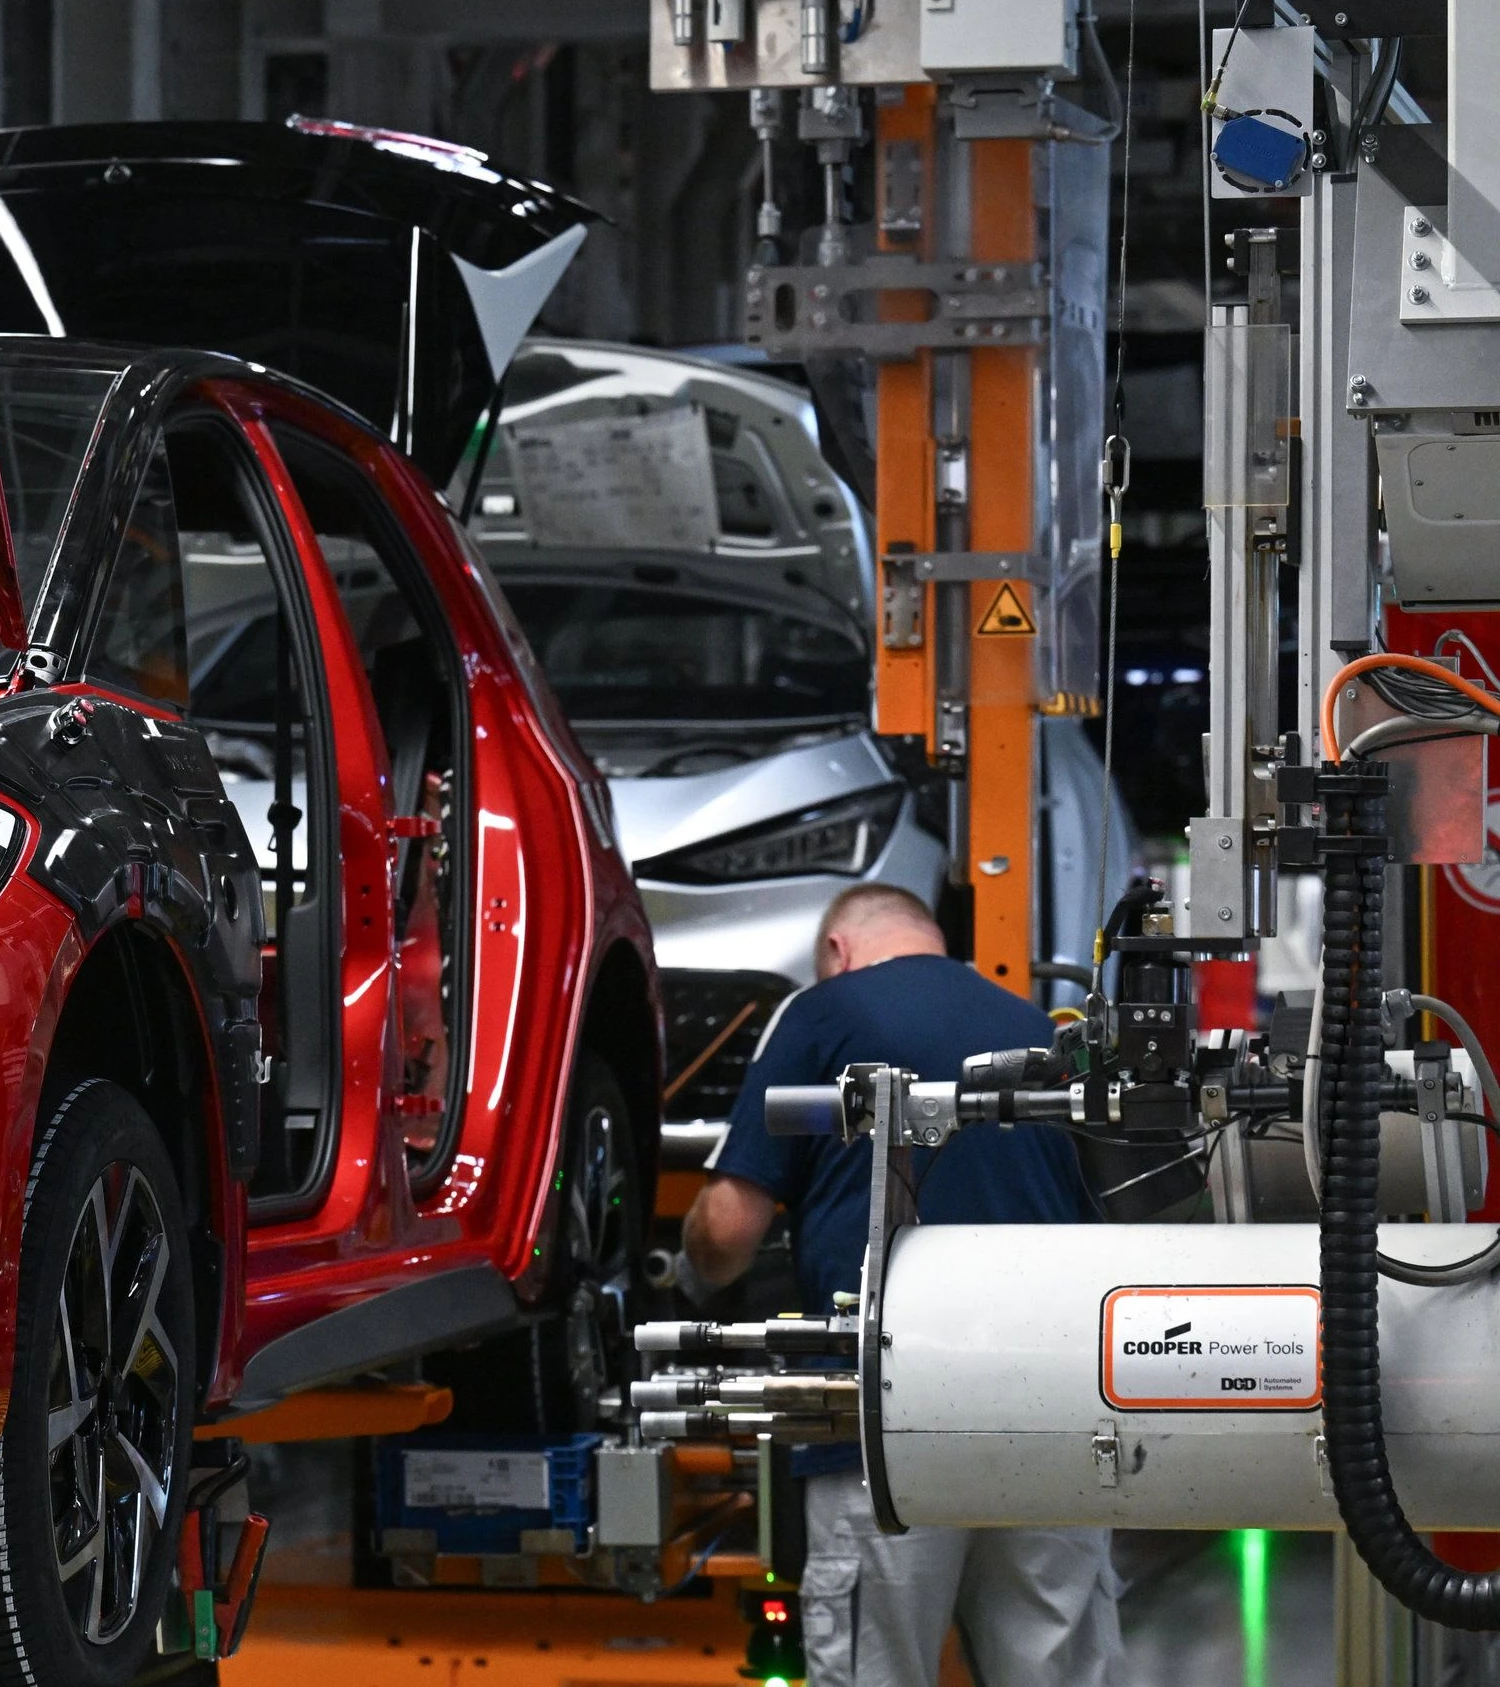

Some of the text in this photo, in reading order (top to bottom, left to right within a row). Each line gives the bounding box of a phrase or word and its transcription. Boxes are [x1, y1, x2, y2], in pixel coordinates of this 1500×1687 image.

[1123, 1341, 1304, 1355] COOPER Power Tools
